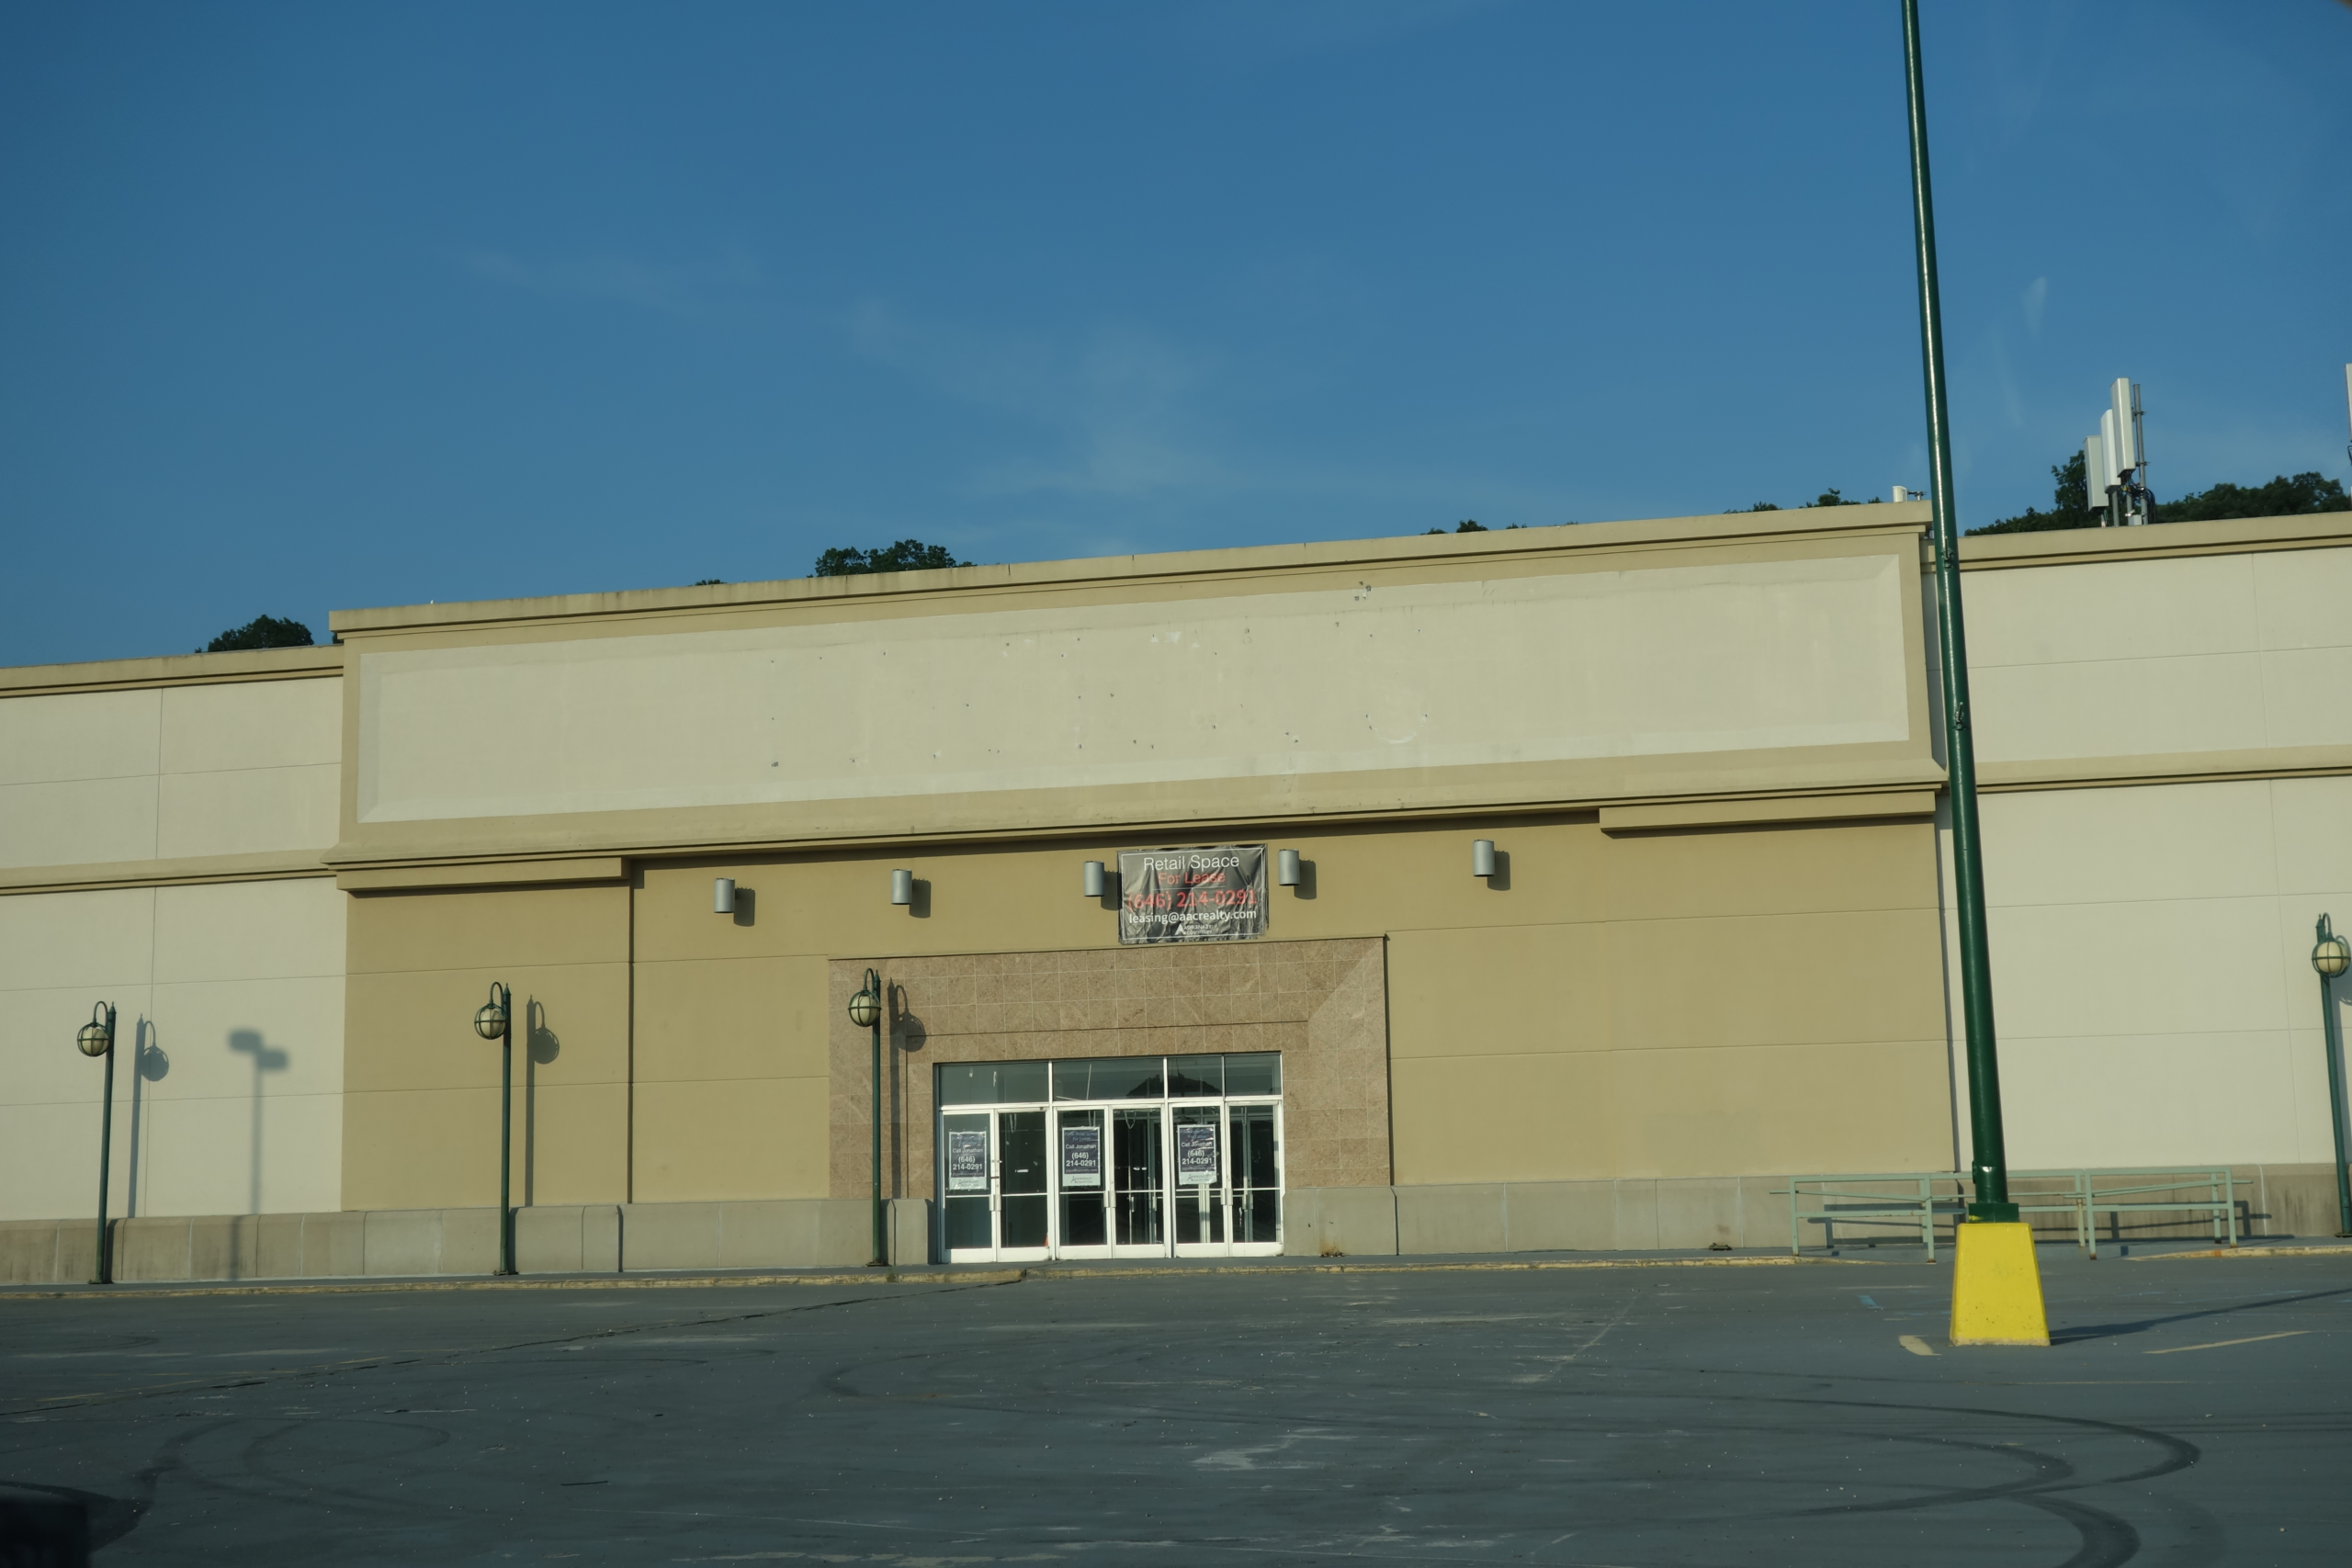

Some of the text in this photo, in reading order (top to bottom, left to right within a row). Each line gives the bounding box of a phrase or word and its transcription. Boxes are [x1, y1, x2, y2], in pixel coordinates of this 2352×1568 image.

[1143, 854, 1240, 872] Retail Space
[1158, 872, 1226, 885] For Lease
[1128, 889, 1256, 912] (646) 214-0291
[1129, 909, 1256, 924] leasing@aacrealty.com
[1187, 1150, 1205, 1158] (646)
